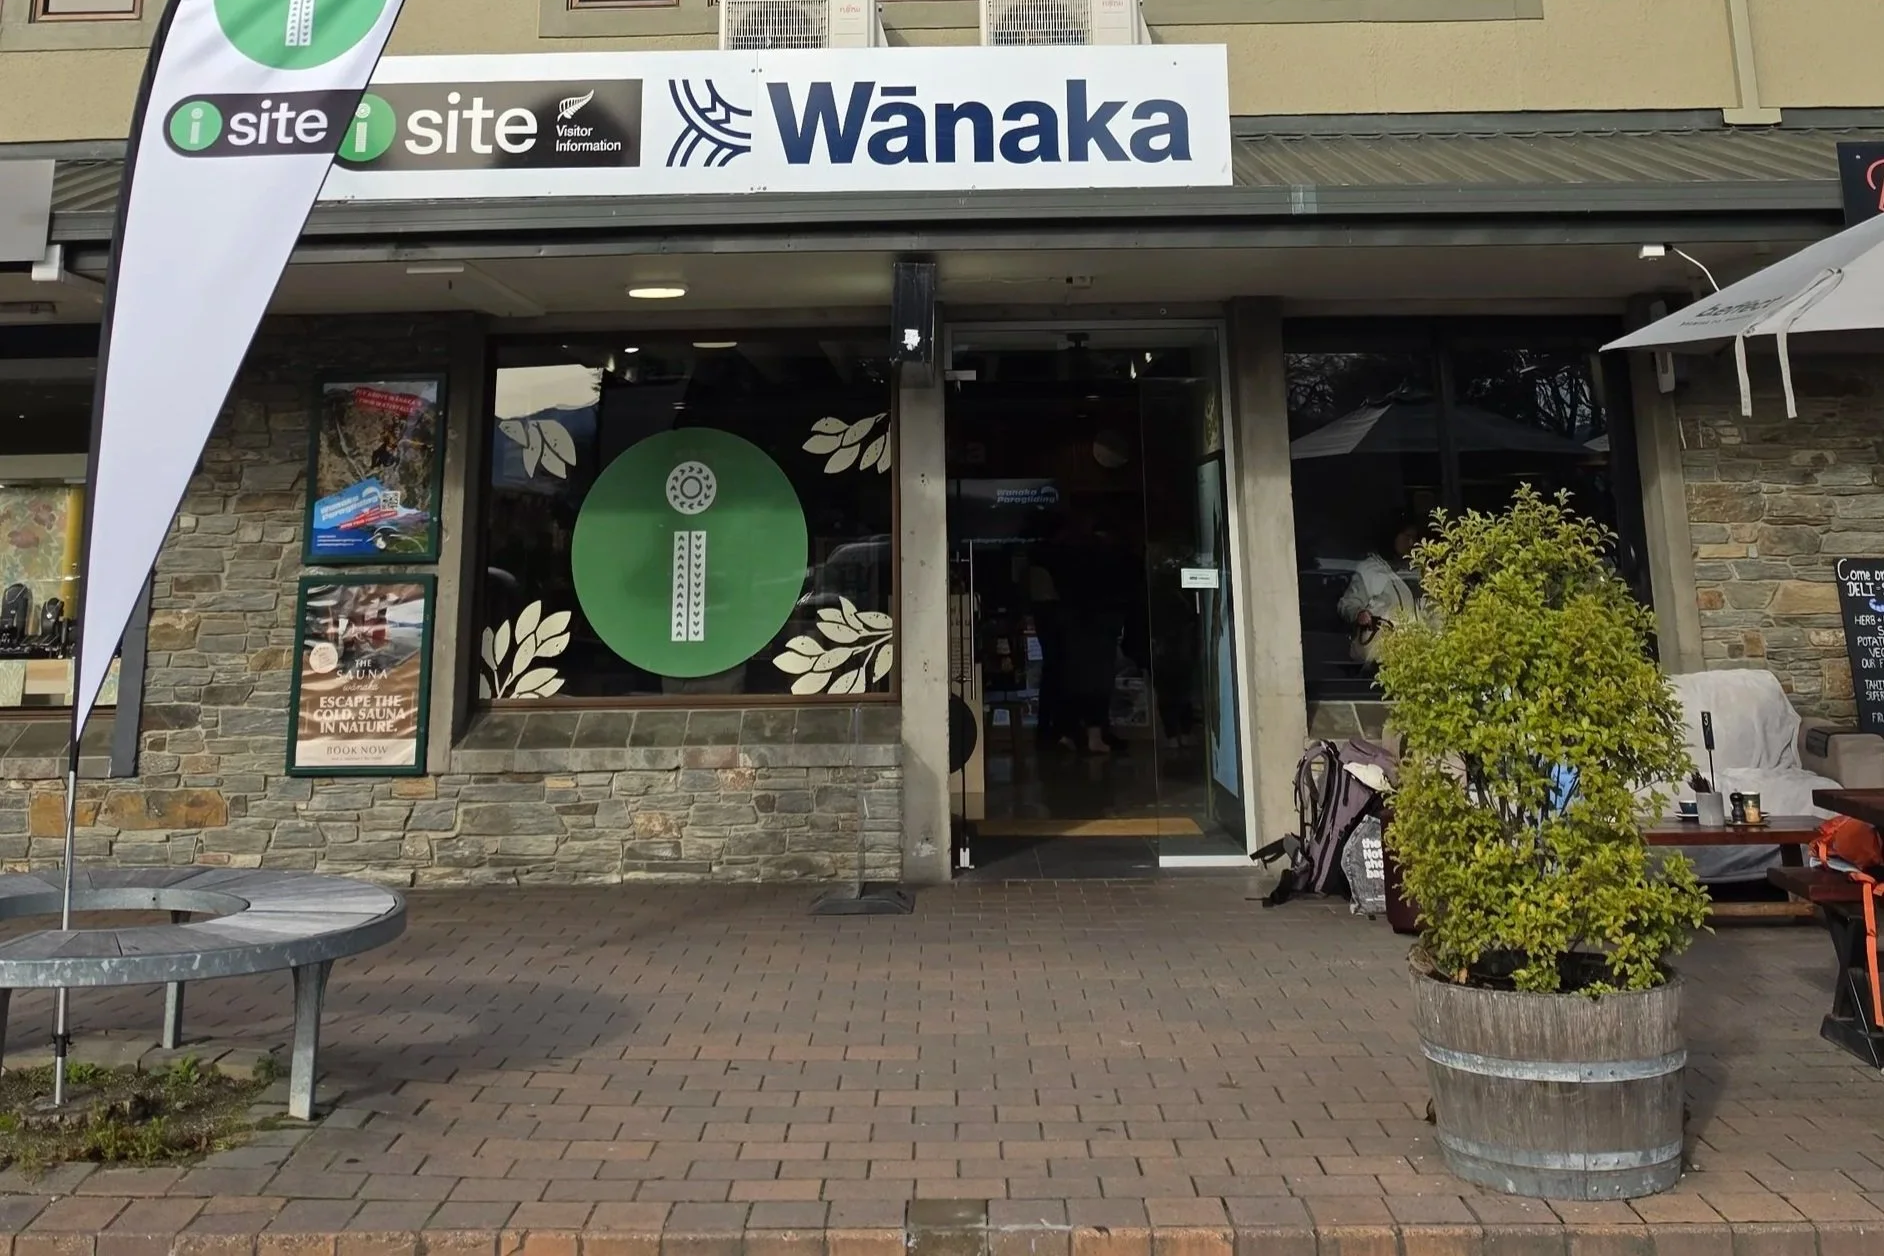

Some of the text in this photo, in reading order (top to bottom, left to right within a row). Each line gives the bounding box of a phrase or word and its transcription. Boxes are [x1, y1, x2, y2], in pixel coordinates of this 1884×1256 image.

[227, 99, 328, 145] site
[404, 91, 538, 155] site
[766, 79, 1193, 166] Wānaka
[556, 125, 594, 137] Visitor
[555, 139, 622, 153] Information
[1837, 558, 1871, 581] Come
[1854, 614, 1876, 626] HERB
[1857, 635, 1884, 646] POTAT
[354, 658, 372, 668] THE
[336, 669, 388, 680] SAUNA
[1864, 679, 1884, 691] TAHI
[319, 695, 401, 708] ESCAPE THE
[313, 708, 406, 721] COLD. SAUNA
[1703, 713, 1709, 726] 3
[319, 721, 398, 734] IN NATURE.
[326, 745, 388, 755] BOOK NOW
